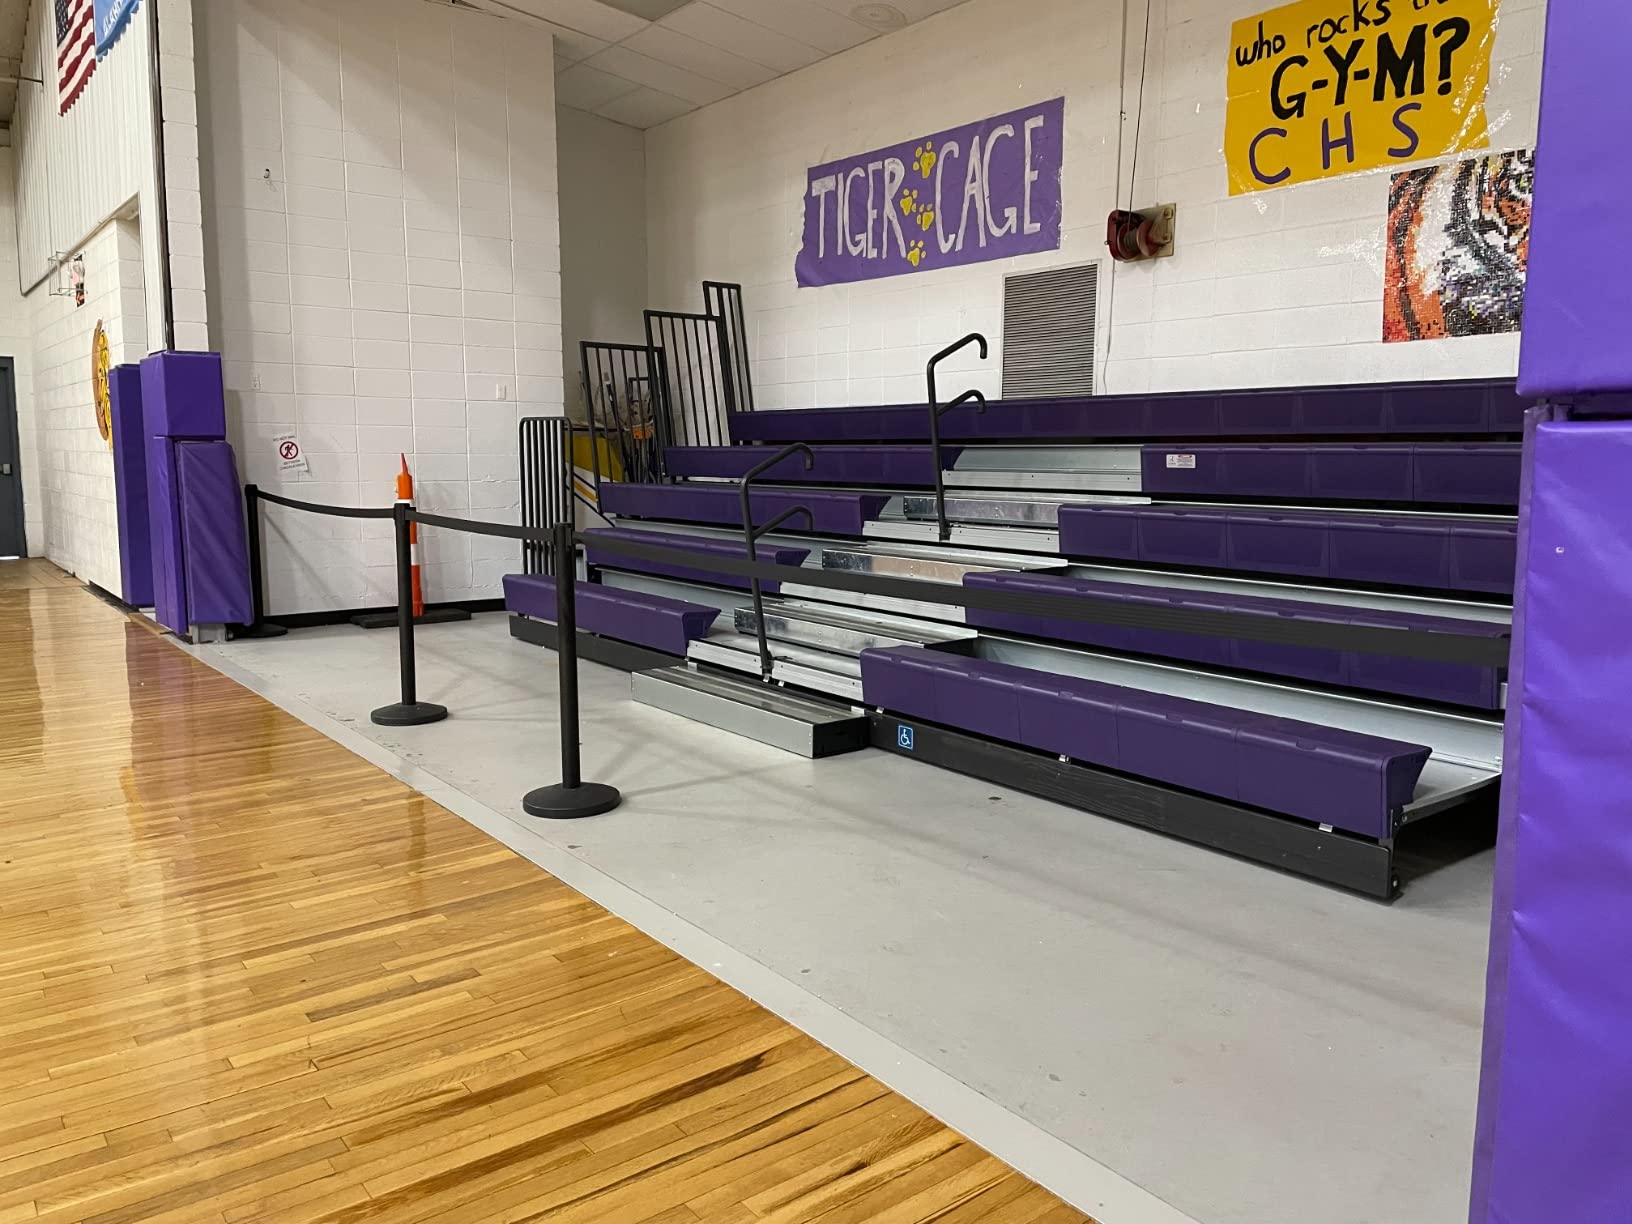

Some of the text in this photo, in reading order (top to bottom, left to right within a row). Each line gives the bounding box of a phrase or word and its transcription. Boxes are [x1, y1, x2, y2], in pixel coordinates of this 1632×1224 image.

[1236, 0, 1392, 66] who rocks
[1270, 17, 1470, 120] G-Y-M?
[811, 115, 1044, 259] TIGER CAGE
